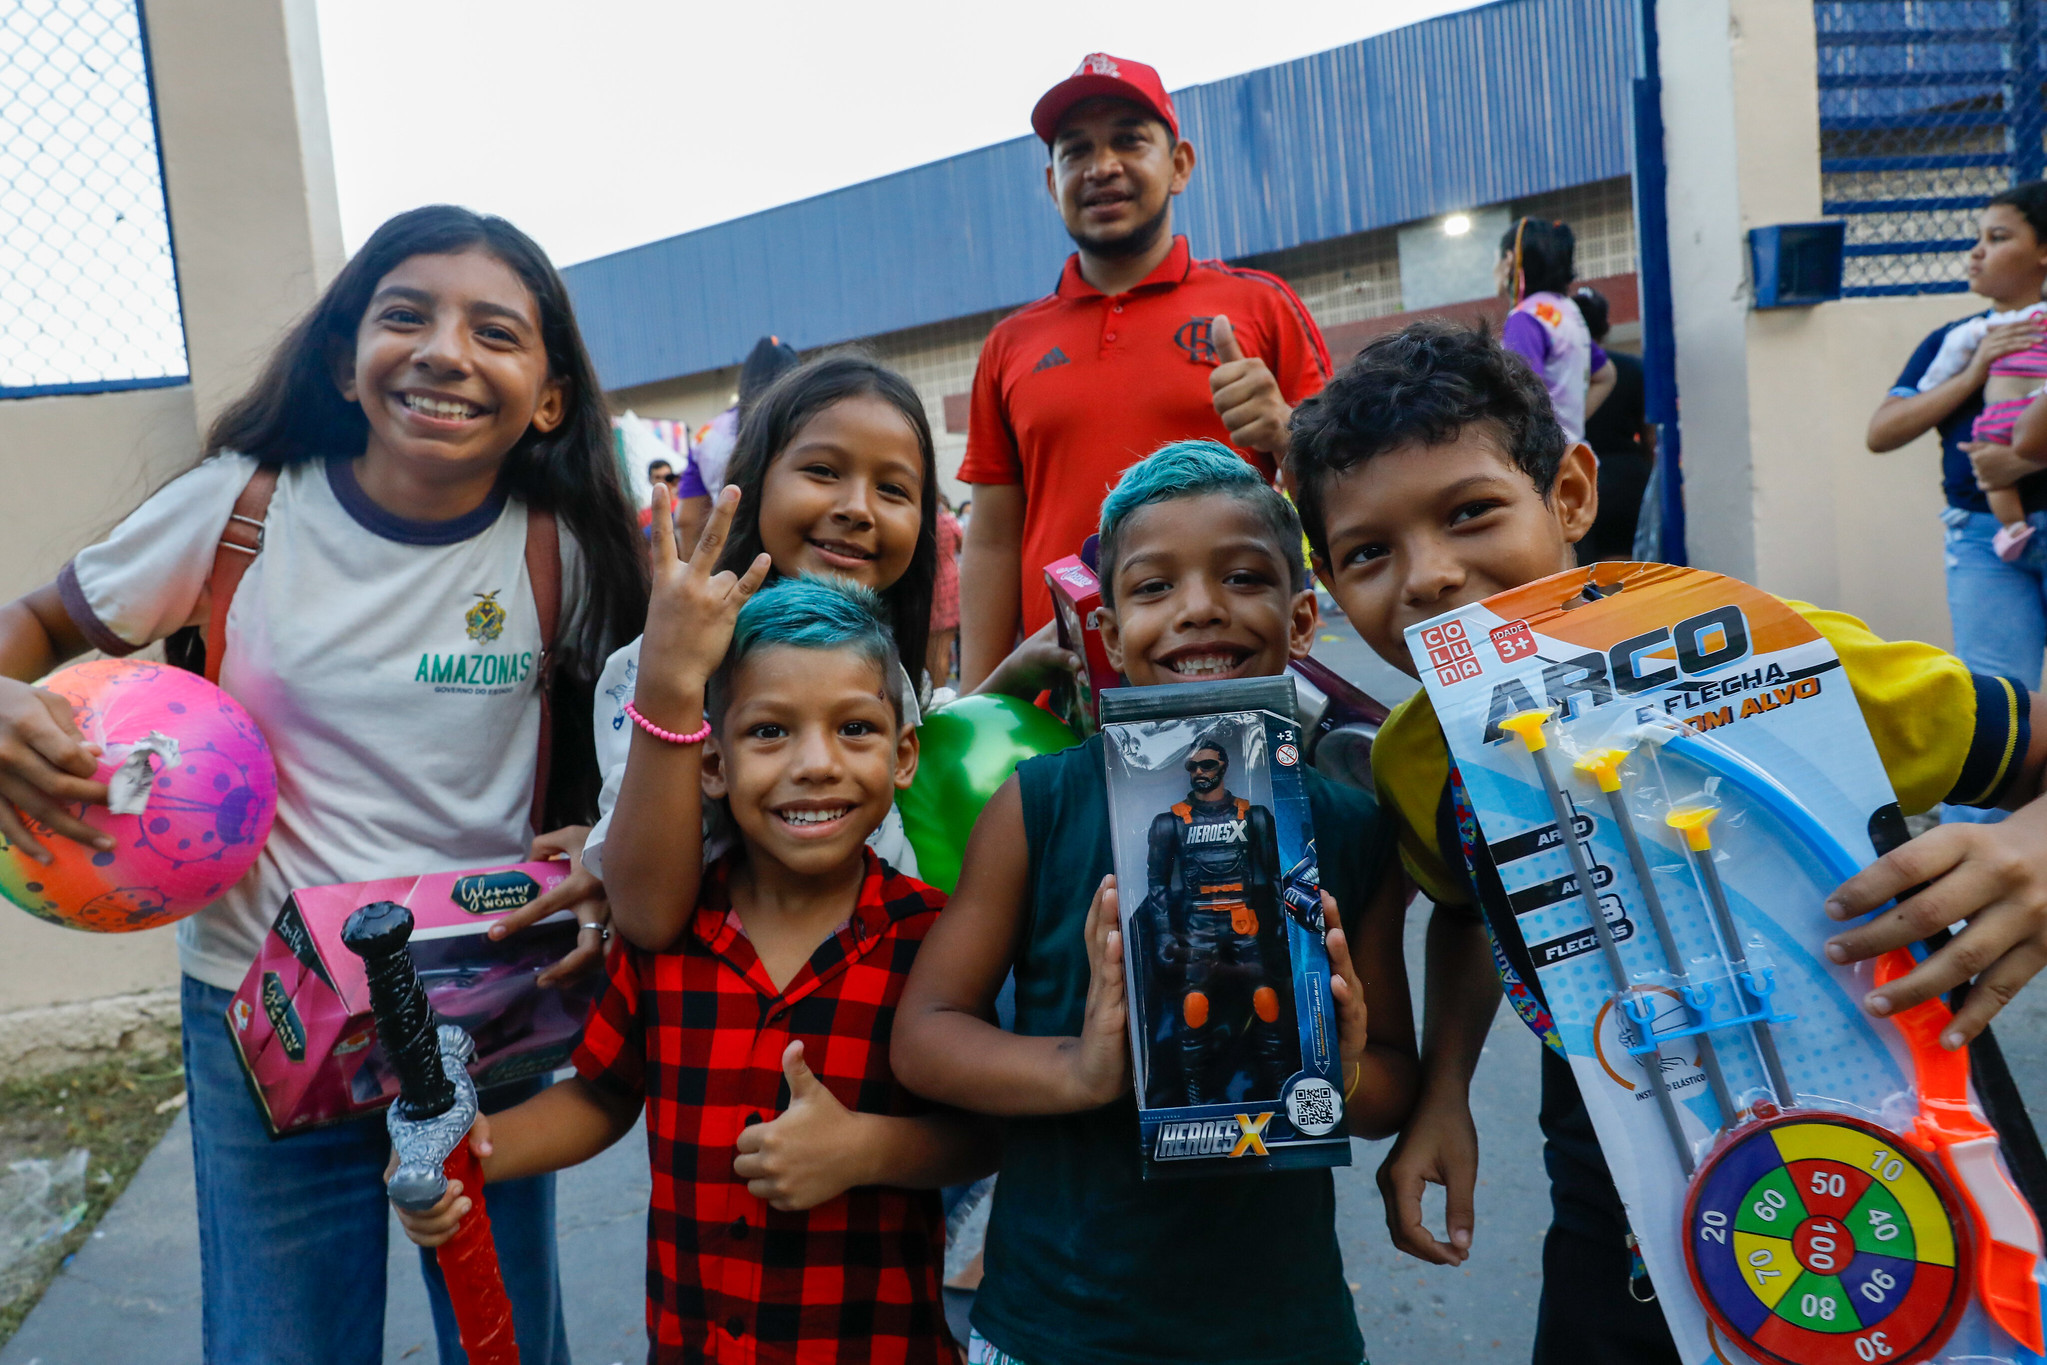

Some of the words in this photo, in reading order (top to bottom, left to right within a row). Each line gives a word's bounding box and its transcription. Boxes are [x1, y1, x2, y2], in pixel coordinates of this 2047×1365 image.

[1493, 624, 1525, 640] IDADE
[1499, 637, 1530, 657] 3+
[414, 652, 532, 685] AMAZONAS
[1482, 604, 1750, 745] ARCO
[434, 686, 473, 695] GOVERNO
[475, 687, 487, 695] DO
[1664, 662, 1788, 715] FLECHA
[1740, 676, 1822, 720] ALVO
[1277, 730, 1294, 741] +3
[1537, 820, 1587, 847] ARO
[1561, 870, 1607, 895] ALO
[482, 896, 528, 909] WORLD
[1672, 1073, 1706, 1090] ELÁSTICO
[1872, 1149, 1905, 1183] 10
[1811, 1171, 1847, 1198] 50
[1752, 1188, 1787, 1222] 60
[1700, 1210, 1729, 1246] 20
[1867, 1208, 1900, 1242] 40
[1808, 1221, 1838, 1271] 100
[1748, 1248, 1782, 1286] 70
[1860, 1268, 1896, 1305] 90
[1801, 1293, 1838, 1322] 80
[1854, 1330, 1895, 1363] 30
